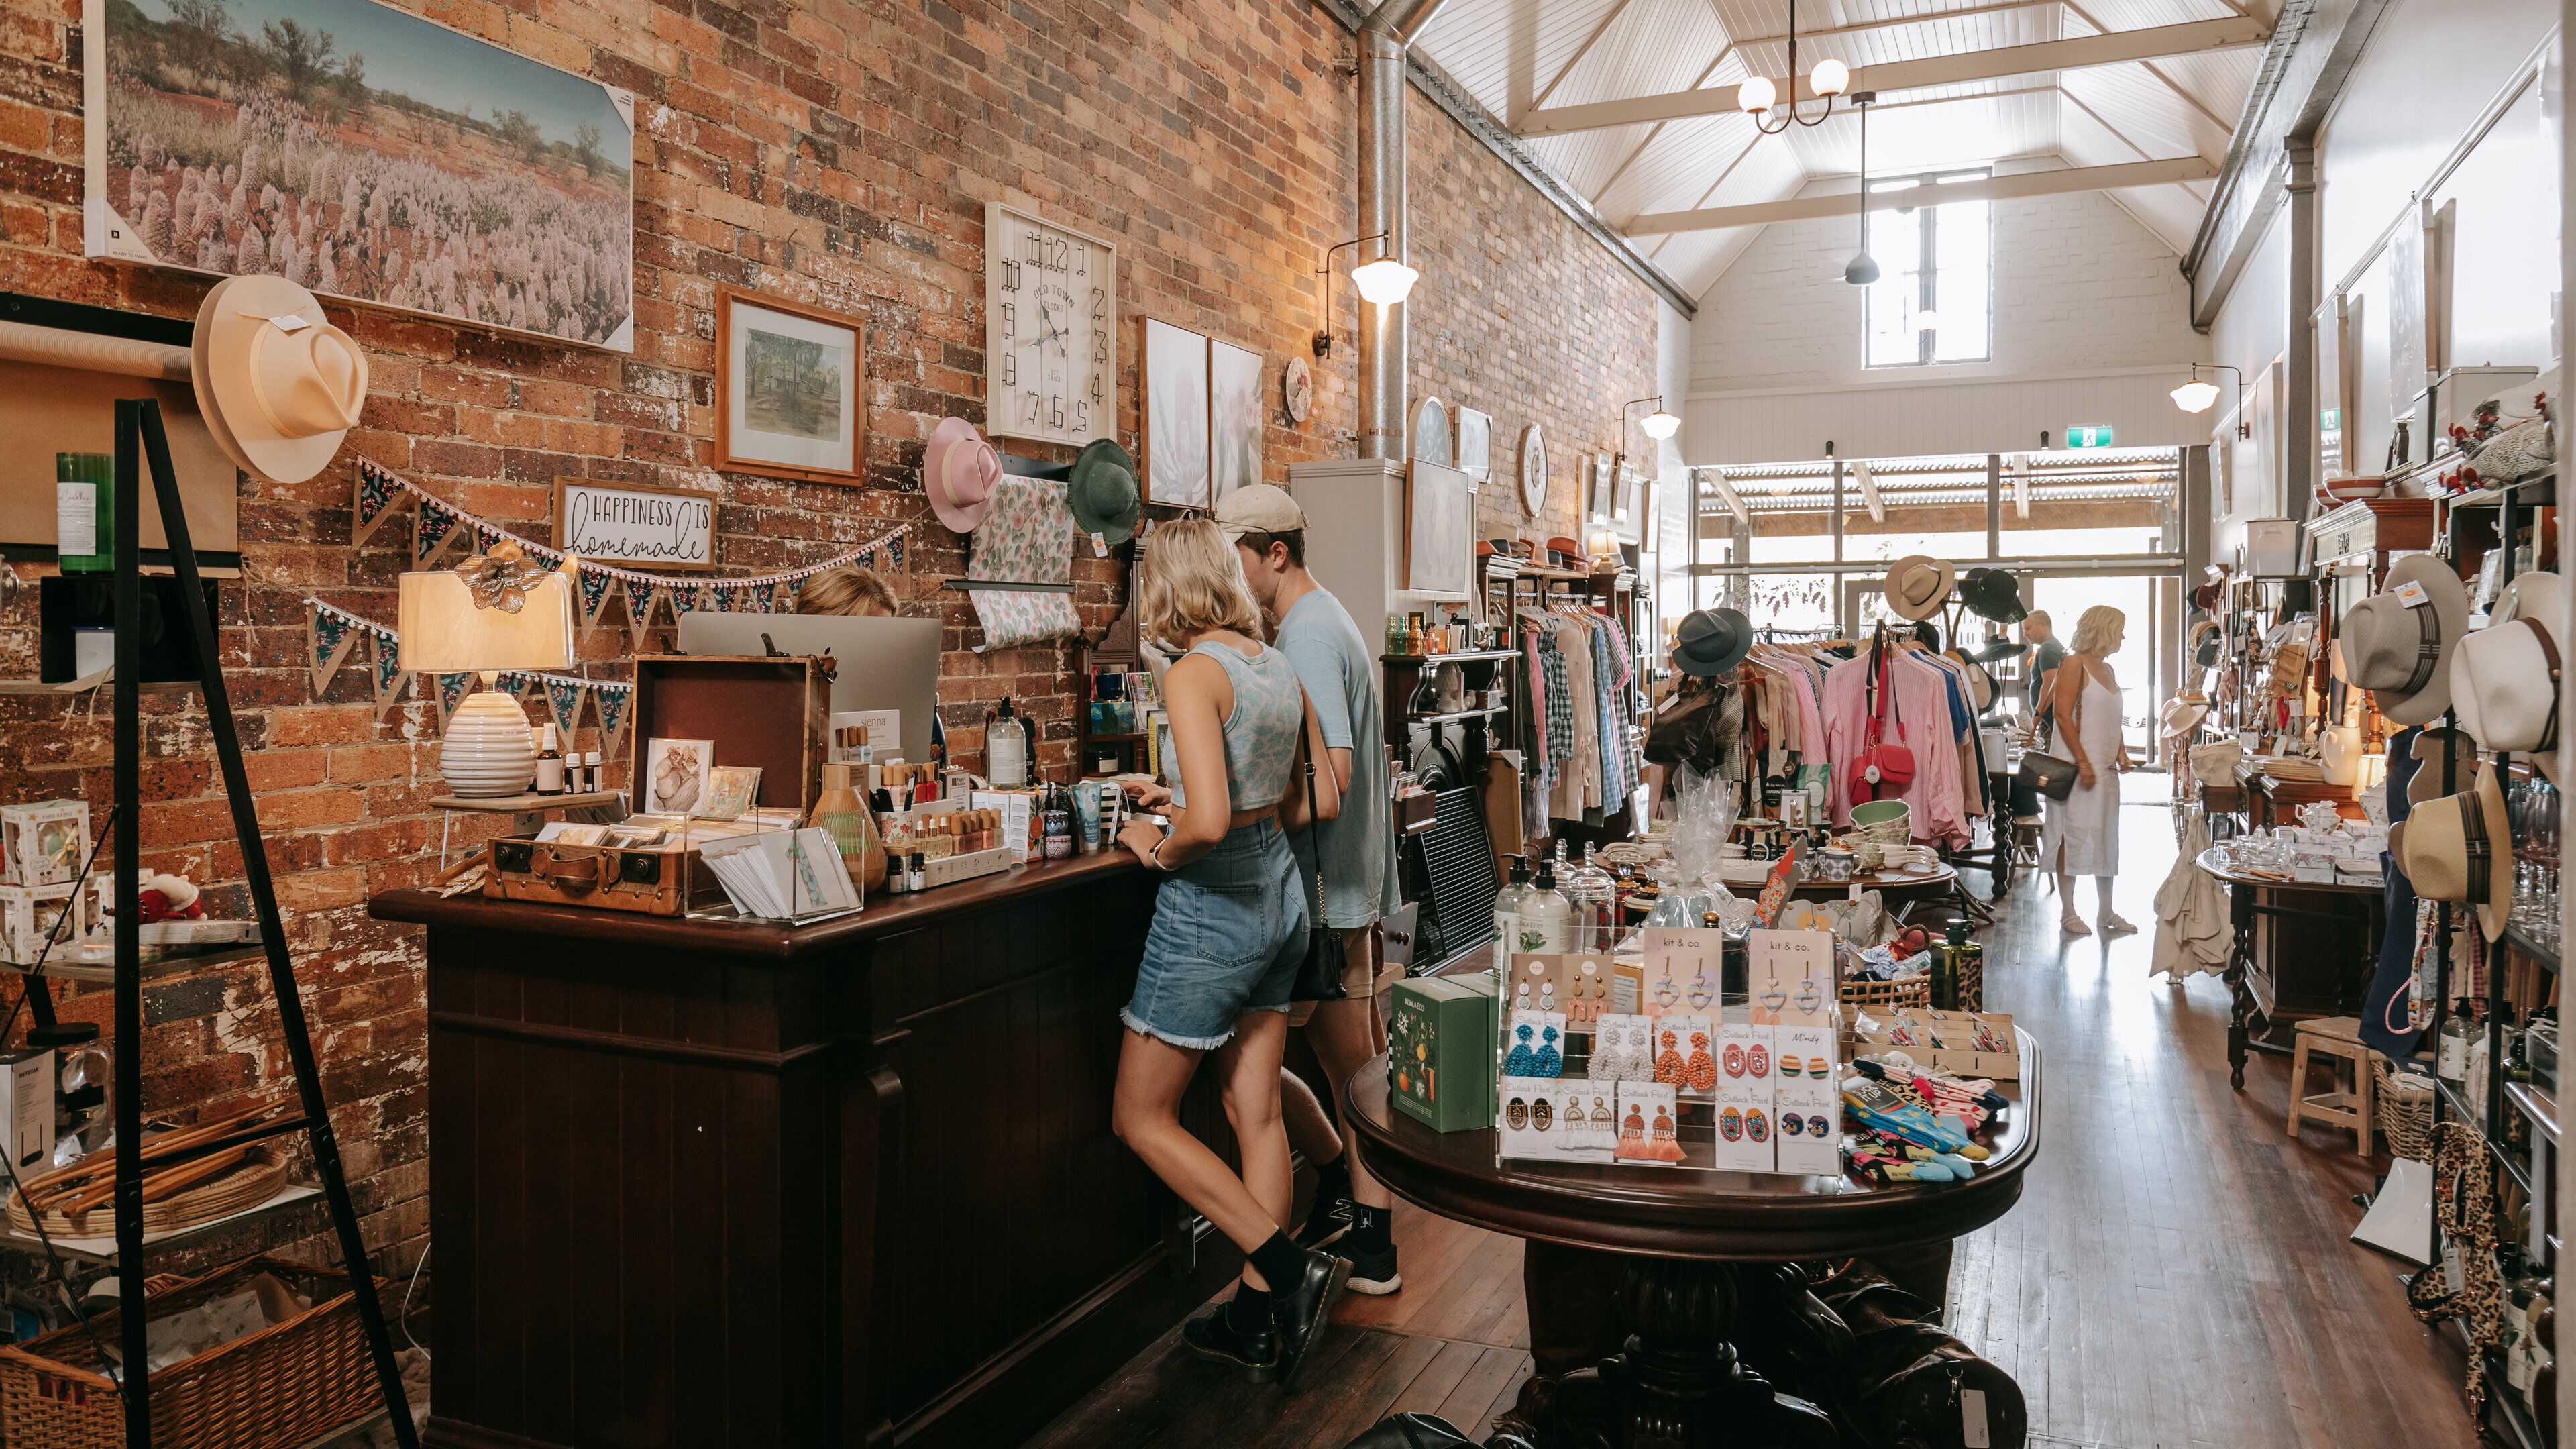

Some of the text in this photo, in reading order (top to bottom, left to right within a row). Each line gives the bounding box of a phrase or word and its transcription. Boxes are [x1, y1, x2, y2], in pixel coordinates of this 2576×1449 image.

[1046, 237, 1068, 274] 12
[1077, 244, 1085, 276] 1
[1034, 284, 1075, 308] OLD TOWN
[1044, 301, 1064, 313] CLOCKS
[1093, 286, 1105, 320] 2
[1002, 302, 1107, 364] 9 3
[1002, 352, 1104, 405] 8 4
[1027, 390, 1087, 432] 7 6 5
[594, 495, 708, 529] HAPPINESS IS
[564, 492, 704, 559] homemade
[861, 716, 885, 727] sienna
[1664, 938, 1674, 947] kit
[1677, 938, 1684, 947] &
[1770, 941, 1781, 950] kit
[1784, 942, 1791, 951] &
[1601, 1020, 1627, 1028] Outback
[1660, 1022, 1686, 1031] Outback
[1721, 1030, 1750, 1039] Outback
[1792, 1033, 1819, 1044] Mindy
[1505, 1083, 1532, 1092] Outback
[1562, 1087, 1590, 1095] Outback
[1621, 1088, 1648, 1097] Outback
[1720, 1094, 1749, 1104] Outback
[1860, 1089, 1882, 1102] IT UP
[1781, 1097, 1811, 1107] Outback
